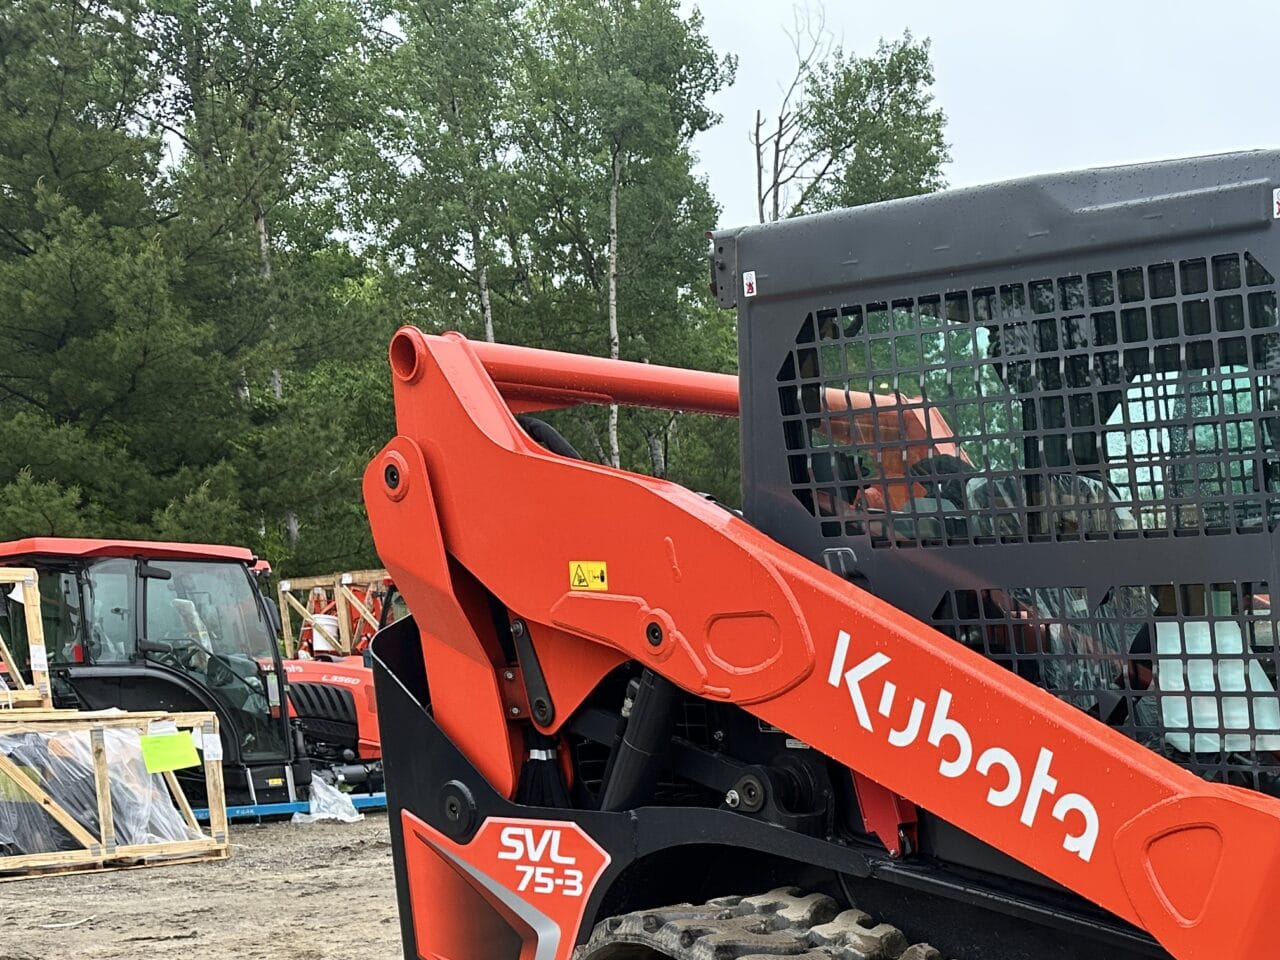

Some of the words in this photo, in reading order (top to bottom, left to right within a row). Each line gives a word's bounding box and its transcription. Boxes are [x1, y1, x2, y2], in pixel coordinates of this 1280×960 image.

[827, 629, 1100, 862] Kubota
[497, 826, 576, 865] SVL
[515, 865, 584, 898] 75-3
